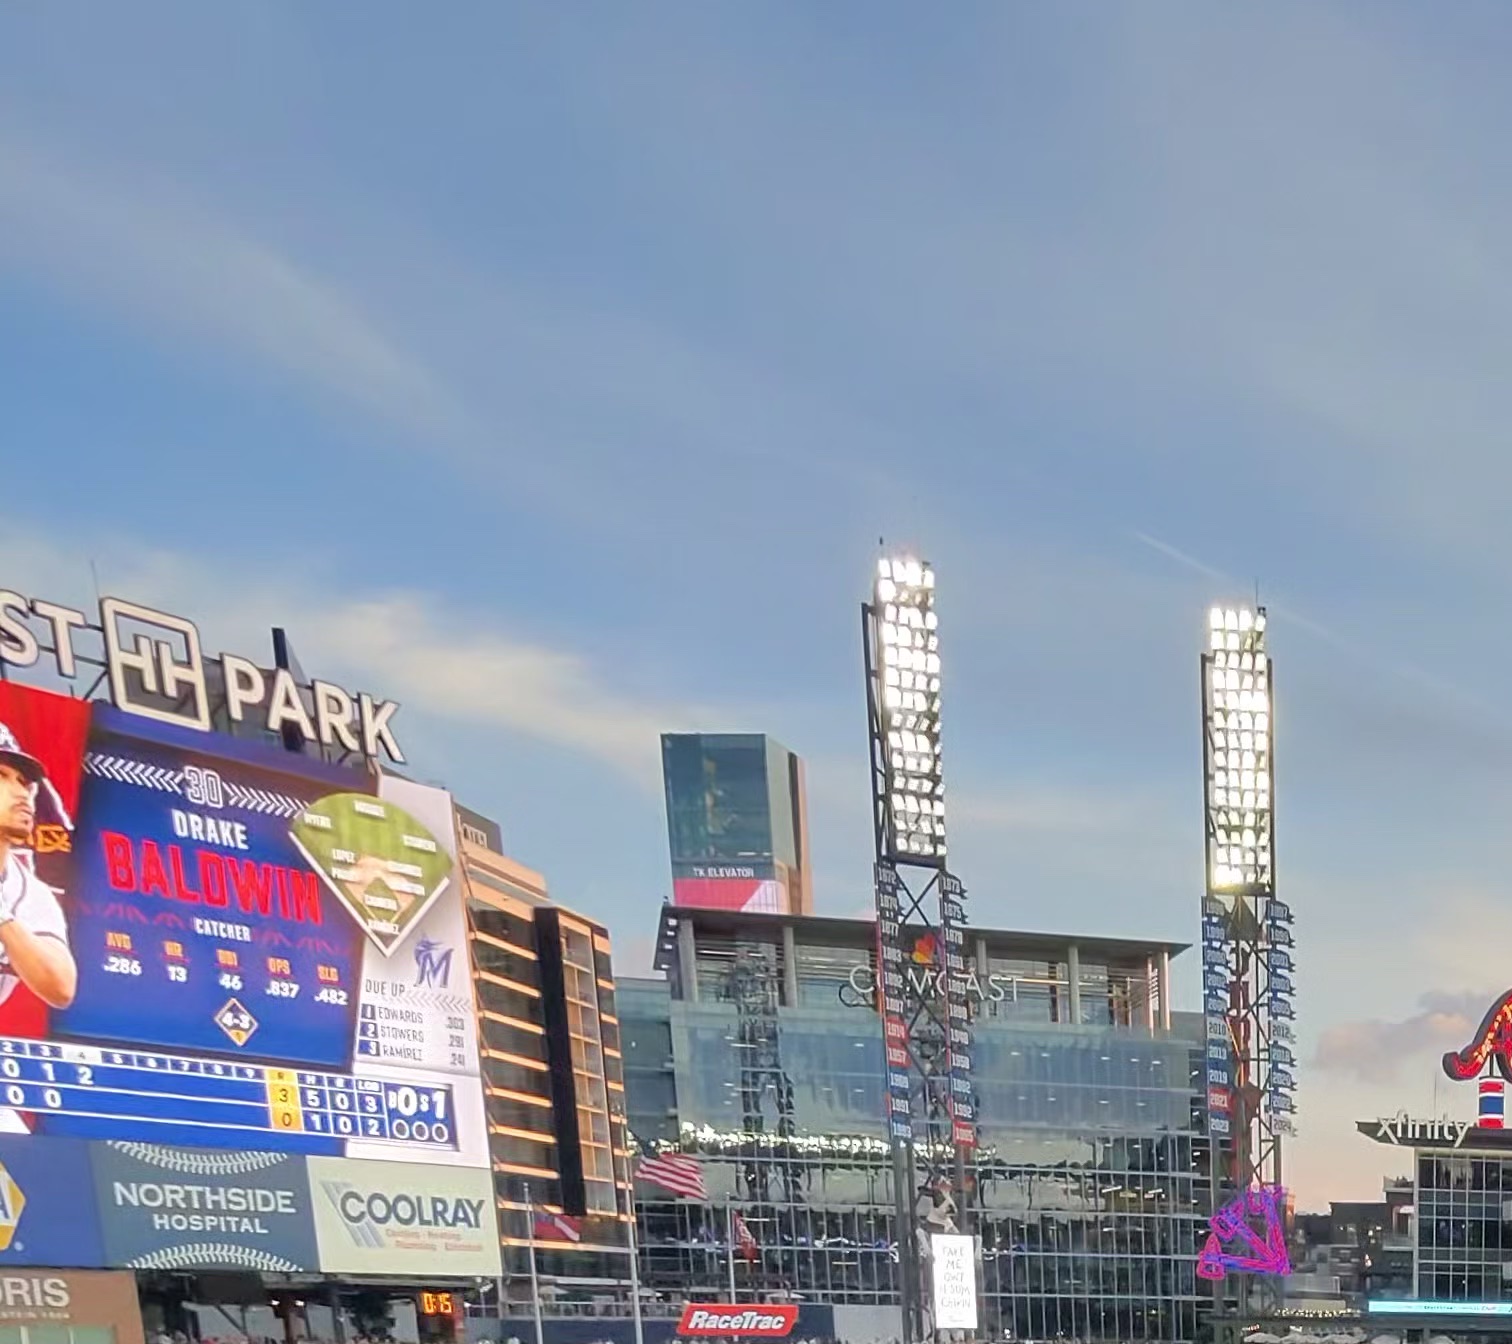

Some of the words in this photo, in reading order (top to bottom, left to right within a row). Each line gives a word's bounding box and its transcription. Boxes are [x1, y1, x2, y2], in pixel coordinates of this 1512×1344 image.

[219, 652, 407, 764] PARK
[184, 766, 224, 808] 30
[171, 809, 249, 850] DRAKE
[101, 830, 324, 925] BALDWIN
[693, 868, 706, 877] TK
[708, 867, 755, 878] ELEVATOR
[193, 917, 251, 942] CATCHER
[104, 957, 142, 976] .286
[167, 965, 187, 983] 13
[219, 974, 242, 991] 46
[265, 981, 299, 998] .837
[314, 988, 348, 1006] .482
[267, 957, 290, 975] OPS
[365, 979, 387, 997] DUE
[390, 984, 405, 998] UP
[378, 1006, 423, 1024] EDWARDS
[380, 1026, 425, 1044] STOWERS
[3, 1059, 20, 1078] 0
[42, 1062, 55, 1082] 1
[76, 1066, 94, 1085] 2
[280, 1088, 289, 1103] 3
[307, 1090, 321, 1107] 5
[336, 1093, 349, 1110] 0
[365, 1096, 378, 1113] 3
[7, 1085, 25, 1105] 0
[44, 1089, 61, 1109] 0
[282, 1112, 293, 1128] 0
[310, 1115, 323, 1131] 1
[341, 1117, 354, 1133] 0
[369, 1120, 381, 1135] 2
[398, 1087, 418, 1117] 0
[432, 1091, 446, 1119] 1
[1376, 1108, 1474, 1148] xfinity
[112, 1181, 297, 1213] NORTHSIDE
[340, 1189, 485, 1228] COOLRAY
[153, 1213, 269, 1234] HOSPITAL
[688, 1311, 786, 1330] RaceTrac
